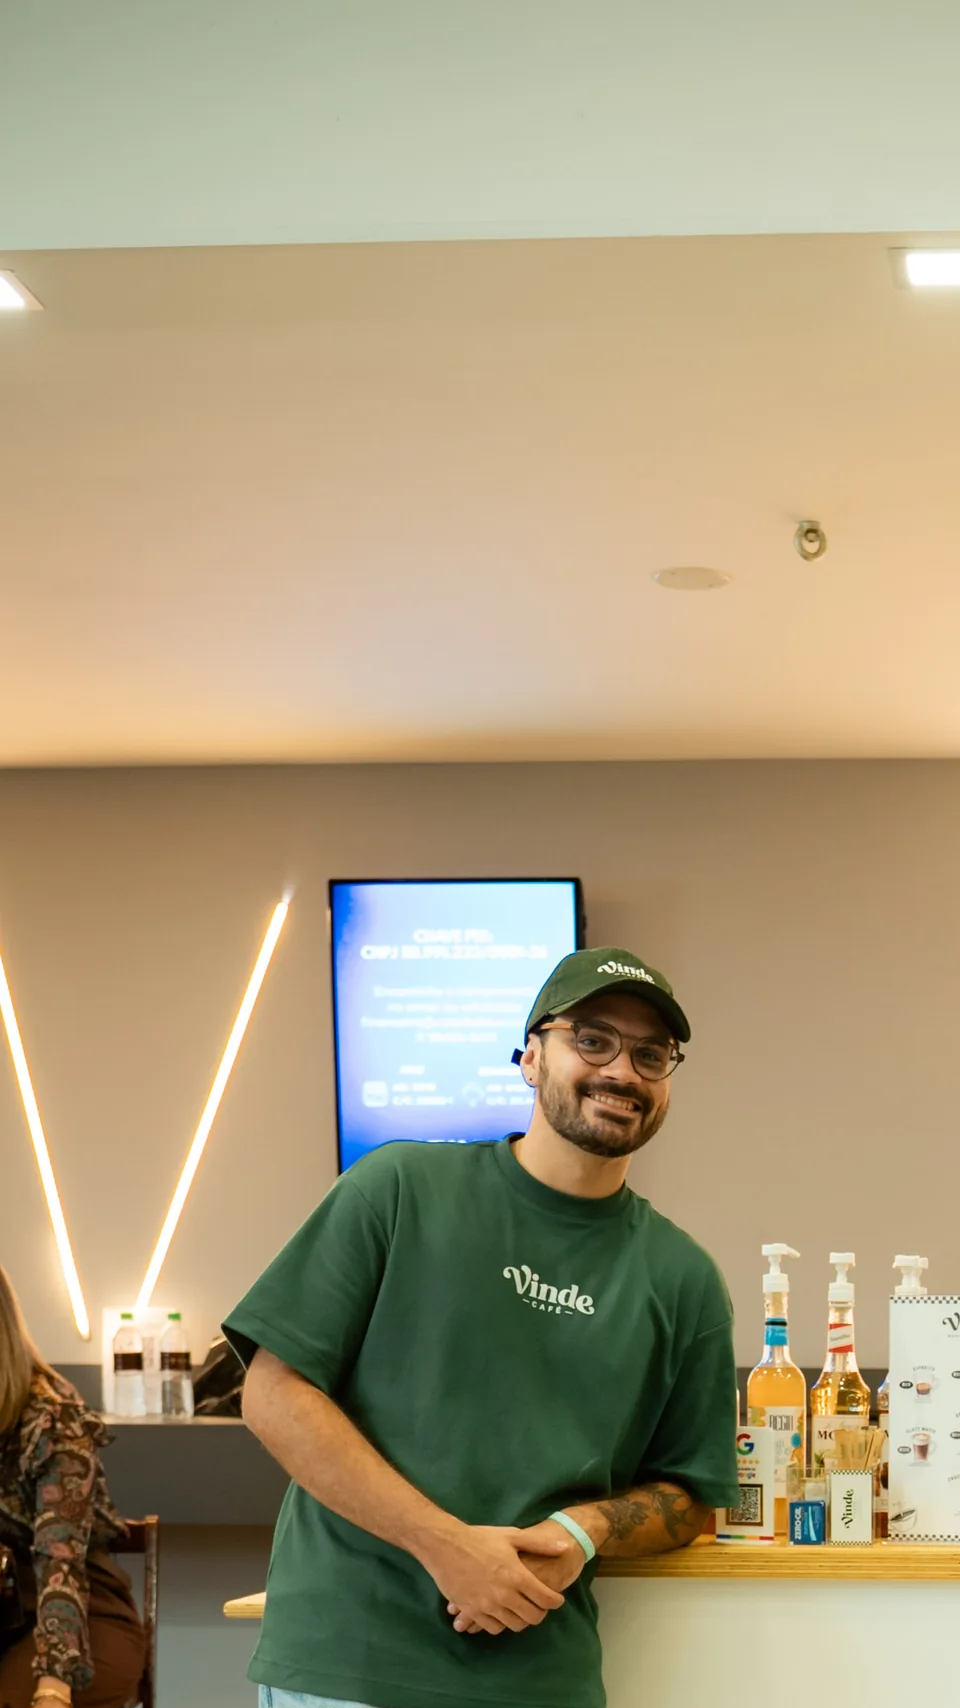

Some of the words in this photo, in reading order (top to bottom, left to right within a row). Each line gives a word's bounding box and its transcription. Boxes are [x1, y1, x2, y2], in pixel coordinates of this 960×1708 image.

[597, 961, 655, 984] Vinde
[503, 1264, 595, 1315] Vinde
[531, 1300, 562, 1314] CAFÉ
[841, 1489, 854, 1529] Vinde
